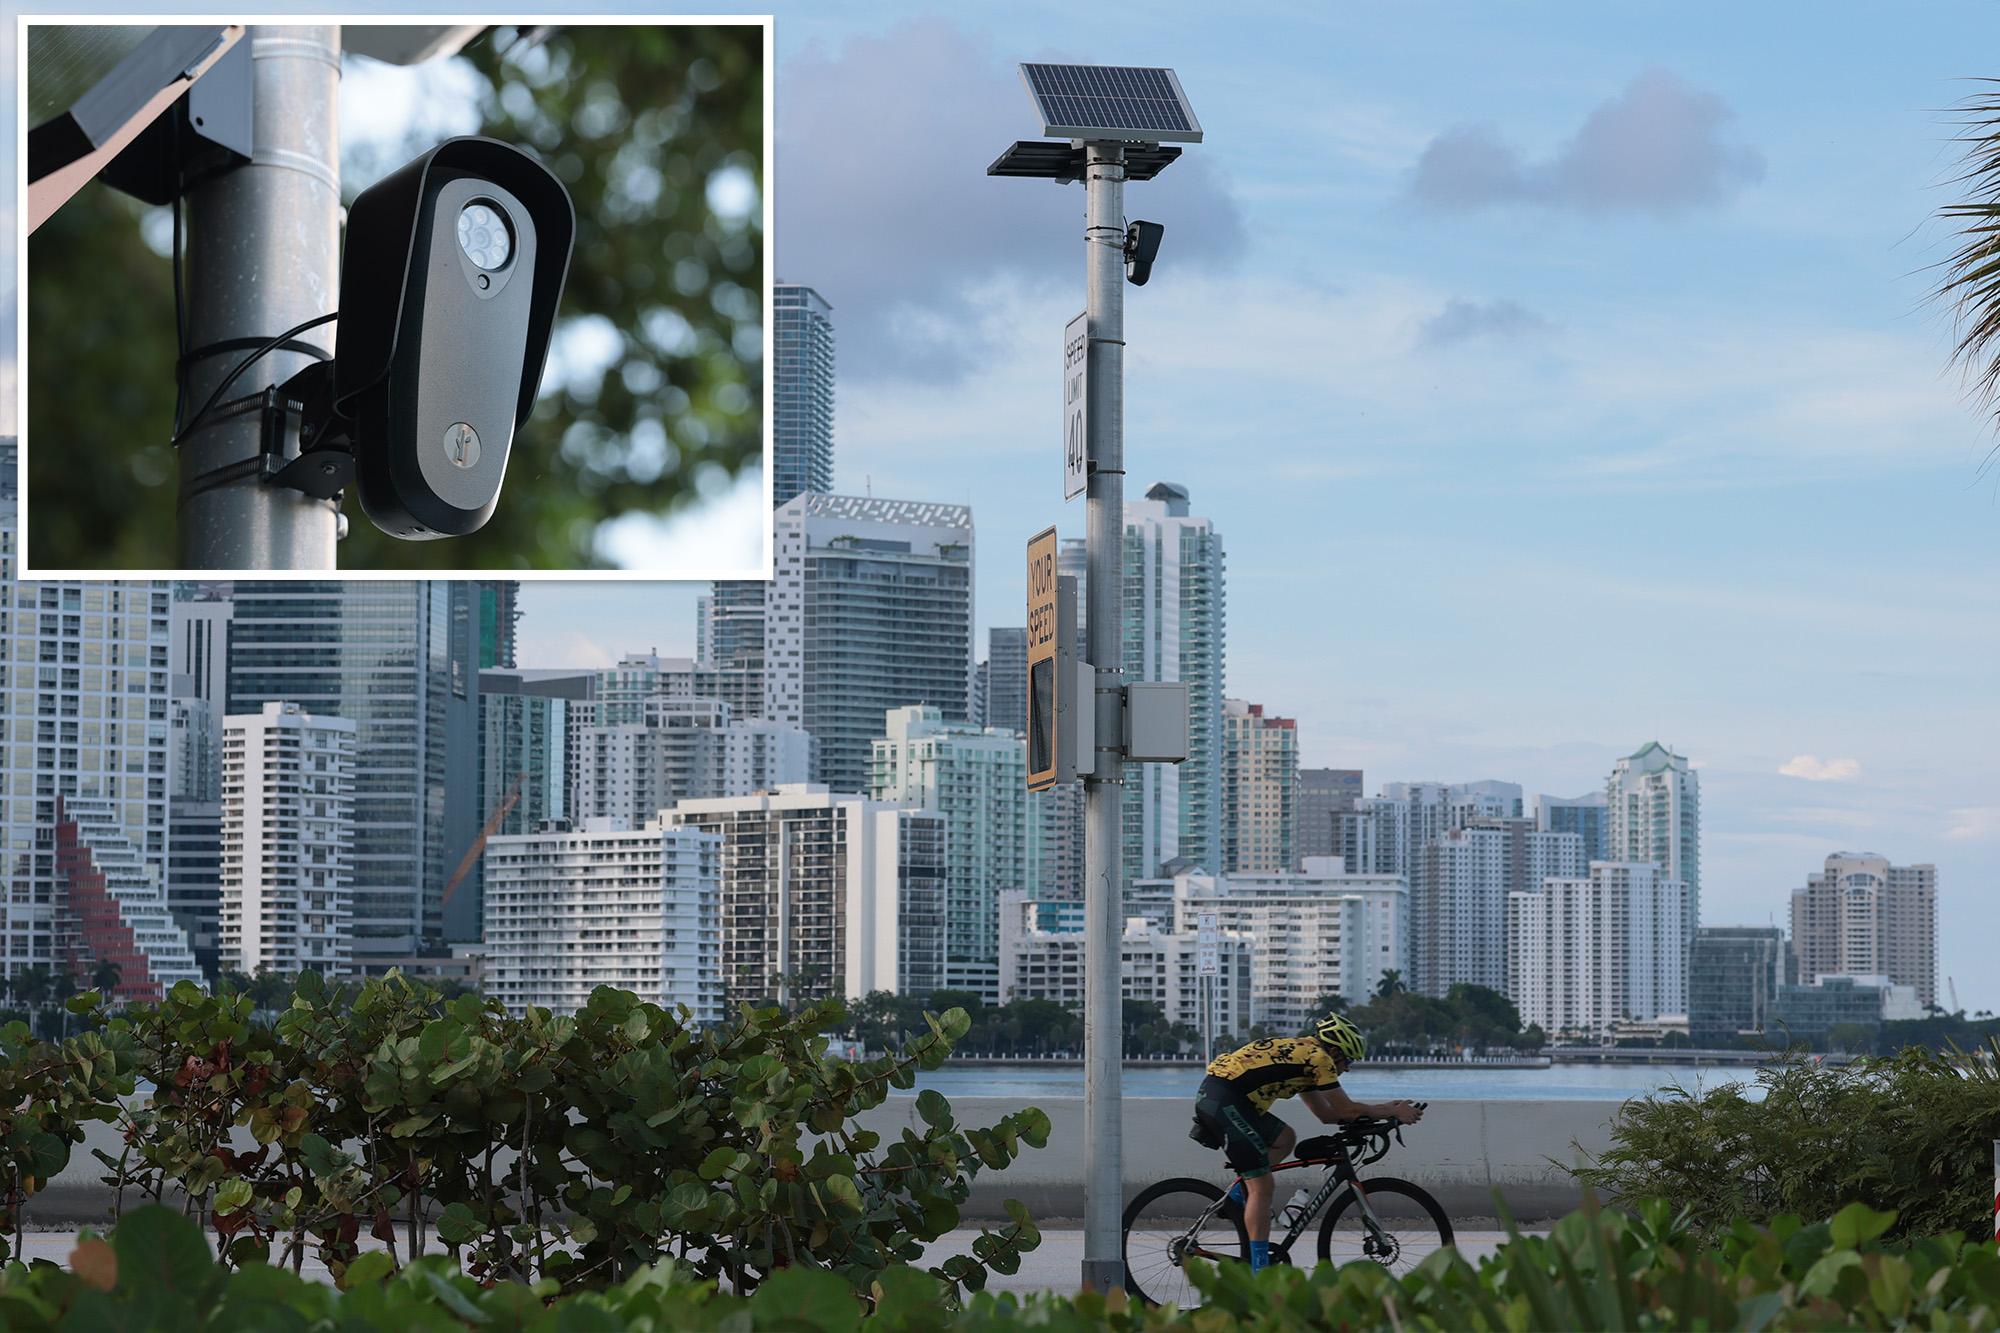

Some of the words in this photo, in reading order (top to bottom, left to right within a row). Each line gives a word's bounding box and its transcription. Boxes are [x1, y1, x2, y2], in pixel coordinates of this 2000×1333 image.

[1066, 333, 1086, 370] SPEED
[1067, 372, 1083, 405] LIMIT
[1067, 409, 1083, 476] 40
[1030, 552, 1053, 599] YOUR
[1029, 602, 1055, 649] SPEED
